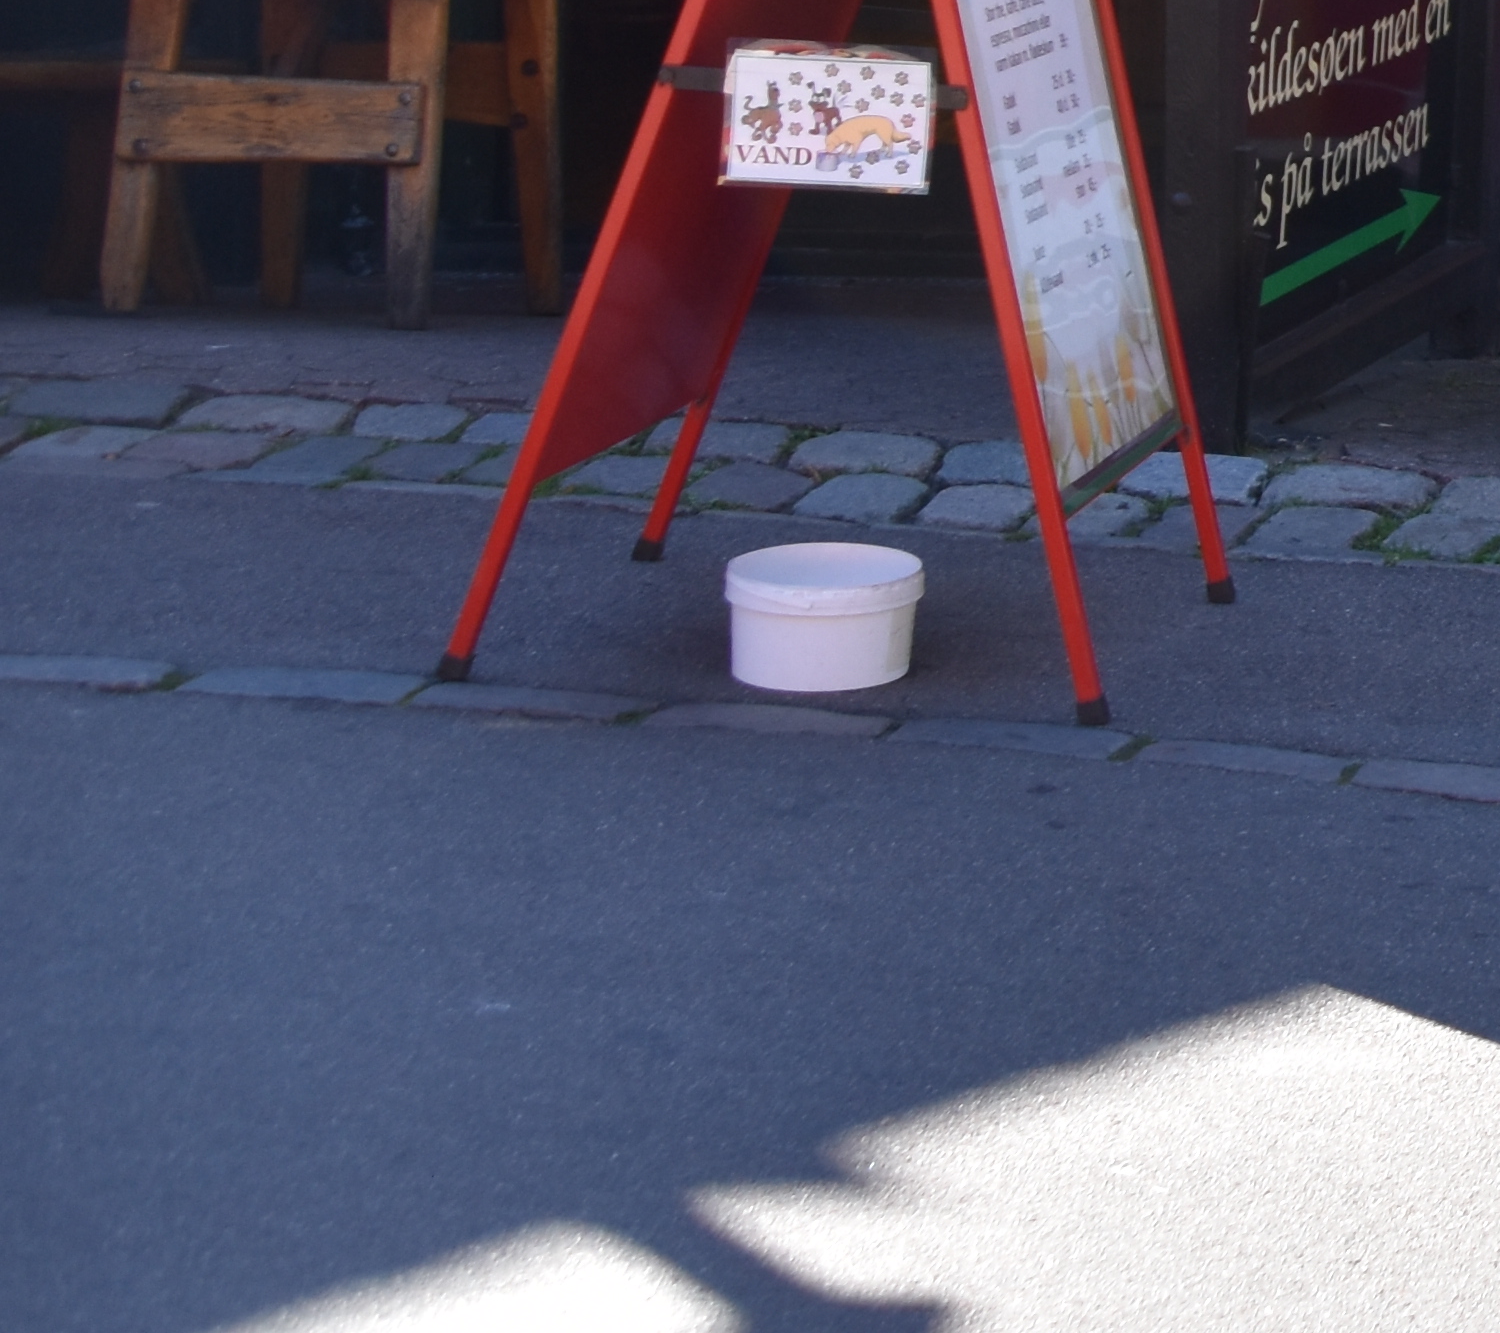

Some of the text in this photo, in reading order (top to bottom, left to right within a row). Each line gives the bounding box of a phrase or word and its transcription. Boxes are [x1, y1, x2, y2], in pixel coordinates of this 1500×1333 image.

[735, 144, 813, 167] VAND
[1279, 131, 1313, 251] på
[1320, 101, 1429, 197] terrassen
